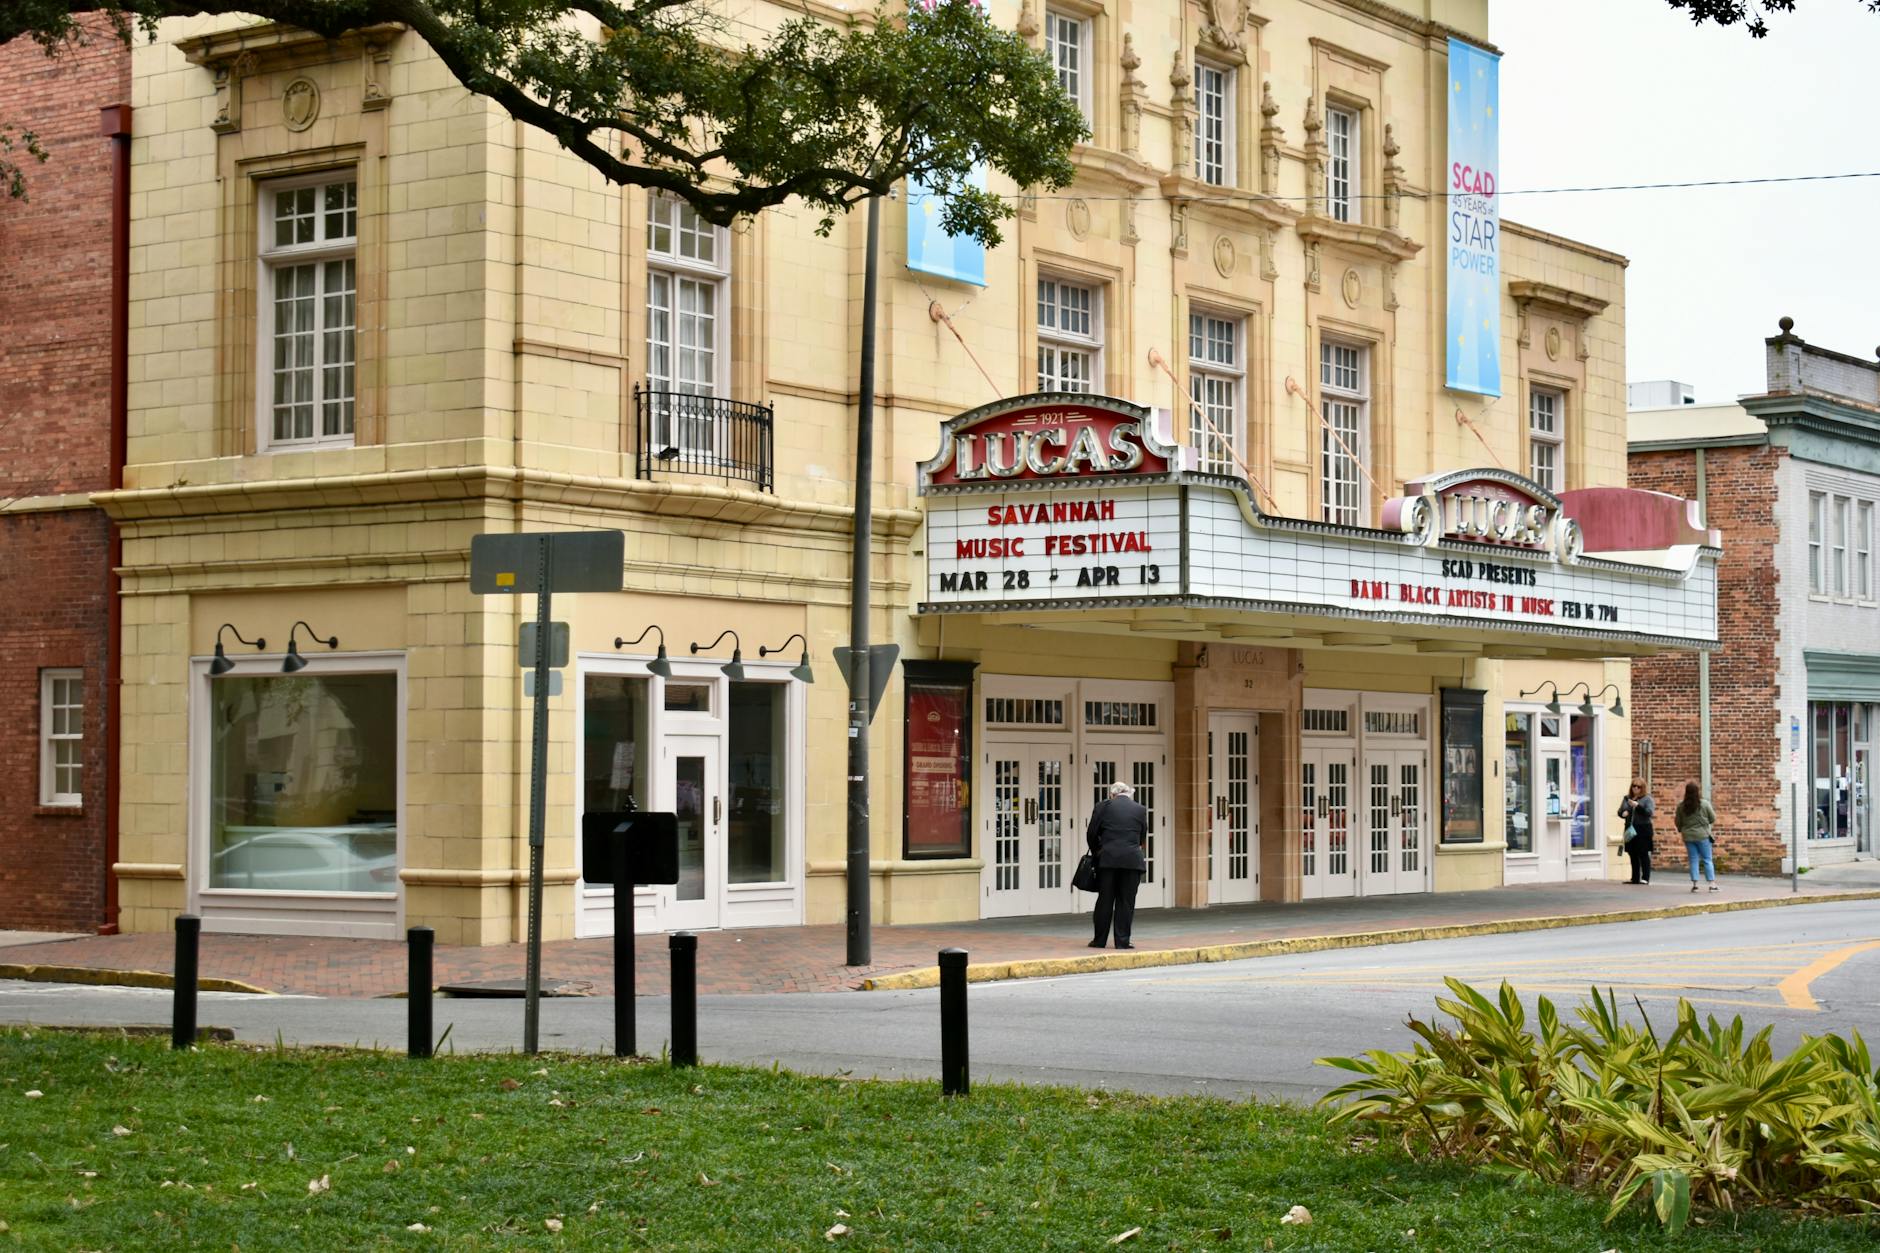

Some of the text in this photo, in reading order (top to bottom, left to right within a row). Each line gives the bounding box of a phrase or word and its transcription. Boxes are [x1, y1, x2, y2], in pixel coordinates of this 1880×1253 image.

[1453, 162, 1495, 198] SCAD
[1452, 195, 1462, 208] 45
[1463, 197, 1487, 215] YEARS
[1452, 211, 1495, 252] STAR
[1452, 246, 1495, 276] POWER
[1040, 412, 1064, 425] 1921
[954, 423, 1144, 480] LUCAS
[987, 500, 1115, 526] SAVANNAH
[1445, 492, 1547, 545] LUCAS
[957, 531, 1152, 560] MUSIC FESTIVAL
[940, 571, 988, 592] MAR
[1003, 570, 1030, 590] 28
[1077, 565, 1119, 587] APR
[1140, 564, 1160, 585] 13
[1442, 559, 1536, 587] SCAD PRESENTS
[1351, 579, 1618, 622] BAM! BLACK ARTISTS IN MUSIC FEB 16 7PM
[1232, 649, 1264, 665] LUCAS
